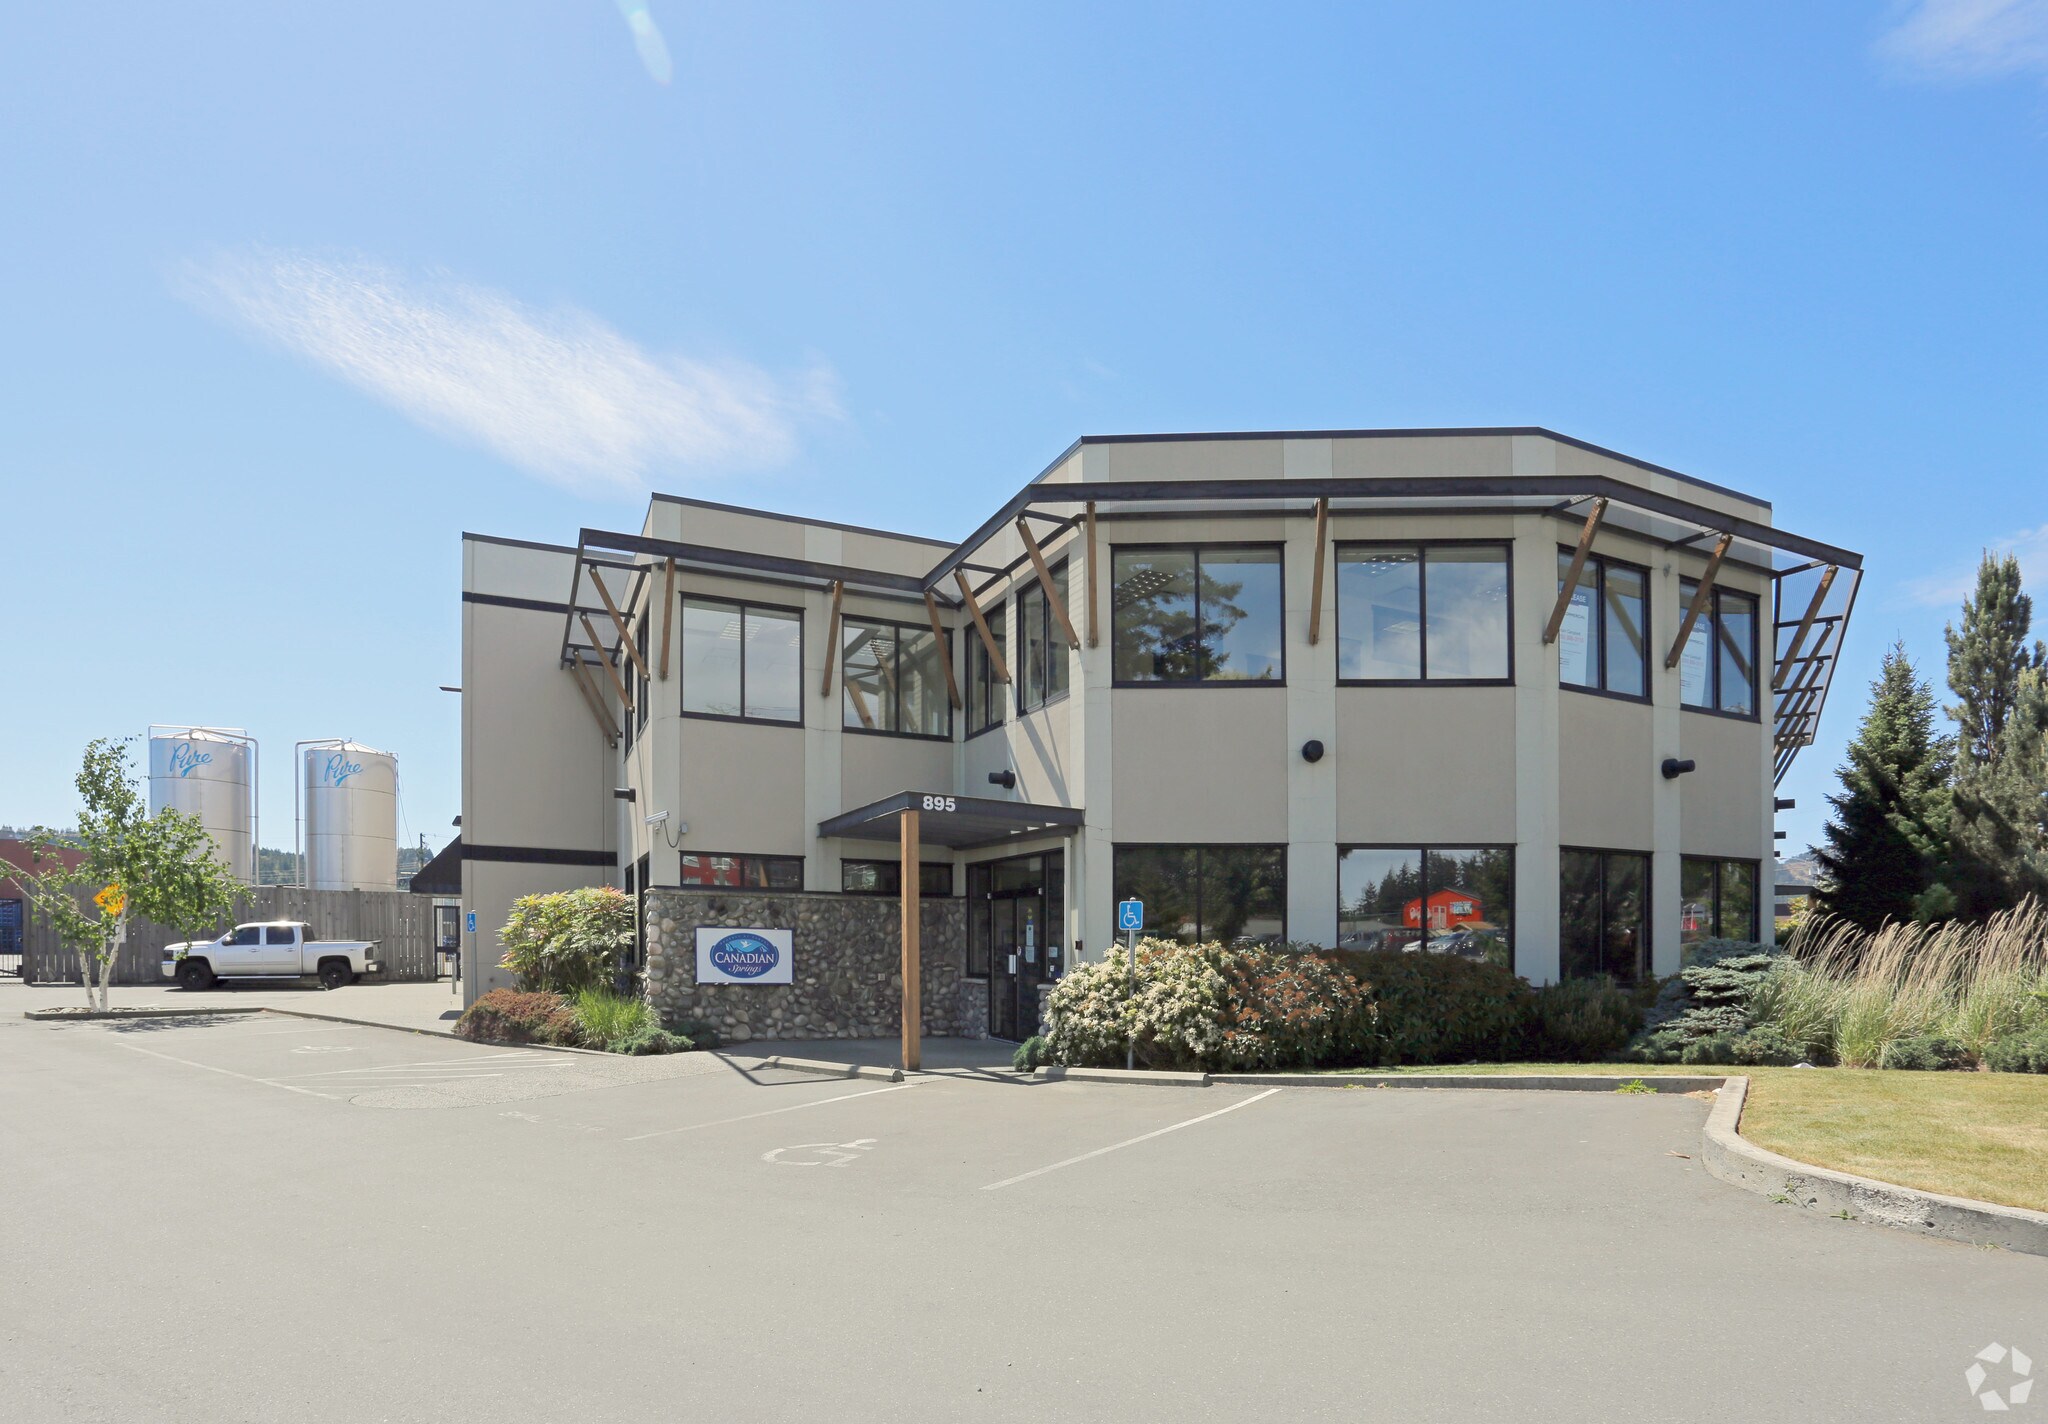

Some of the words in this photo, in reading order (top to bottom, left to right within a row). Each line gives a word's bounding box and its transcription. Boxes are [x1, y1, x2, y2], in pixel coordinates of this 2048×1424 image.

[1571, 593, 1587, 603] EASE
[169, 742, 214, 778] Pure
[324, 753, 364, 787] Pure
[922, 795, 956, 812] 895
[715, 951, 775, 964] CANADIAN
[728, 963, 762, 976] Springs
